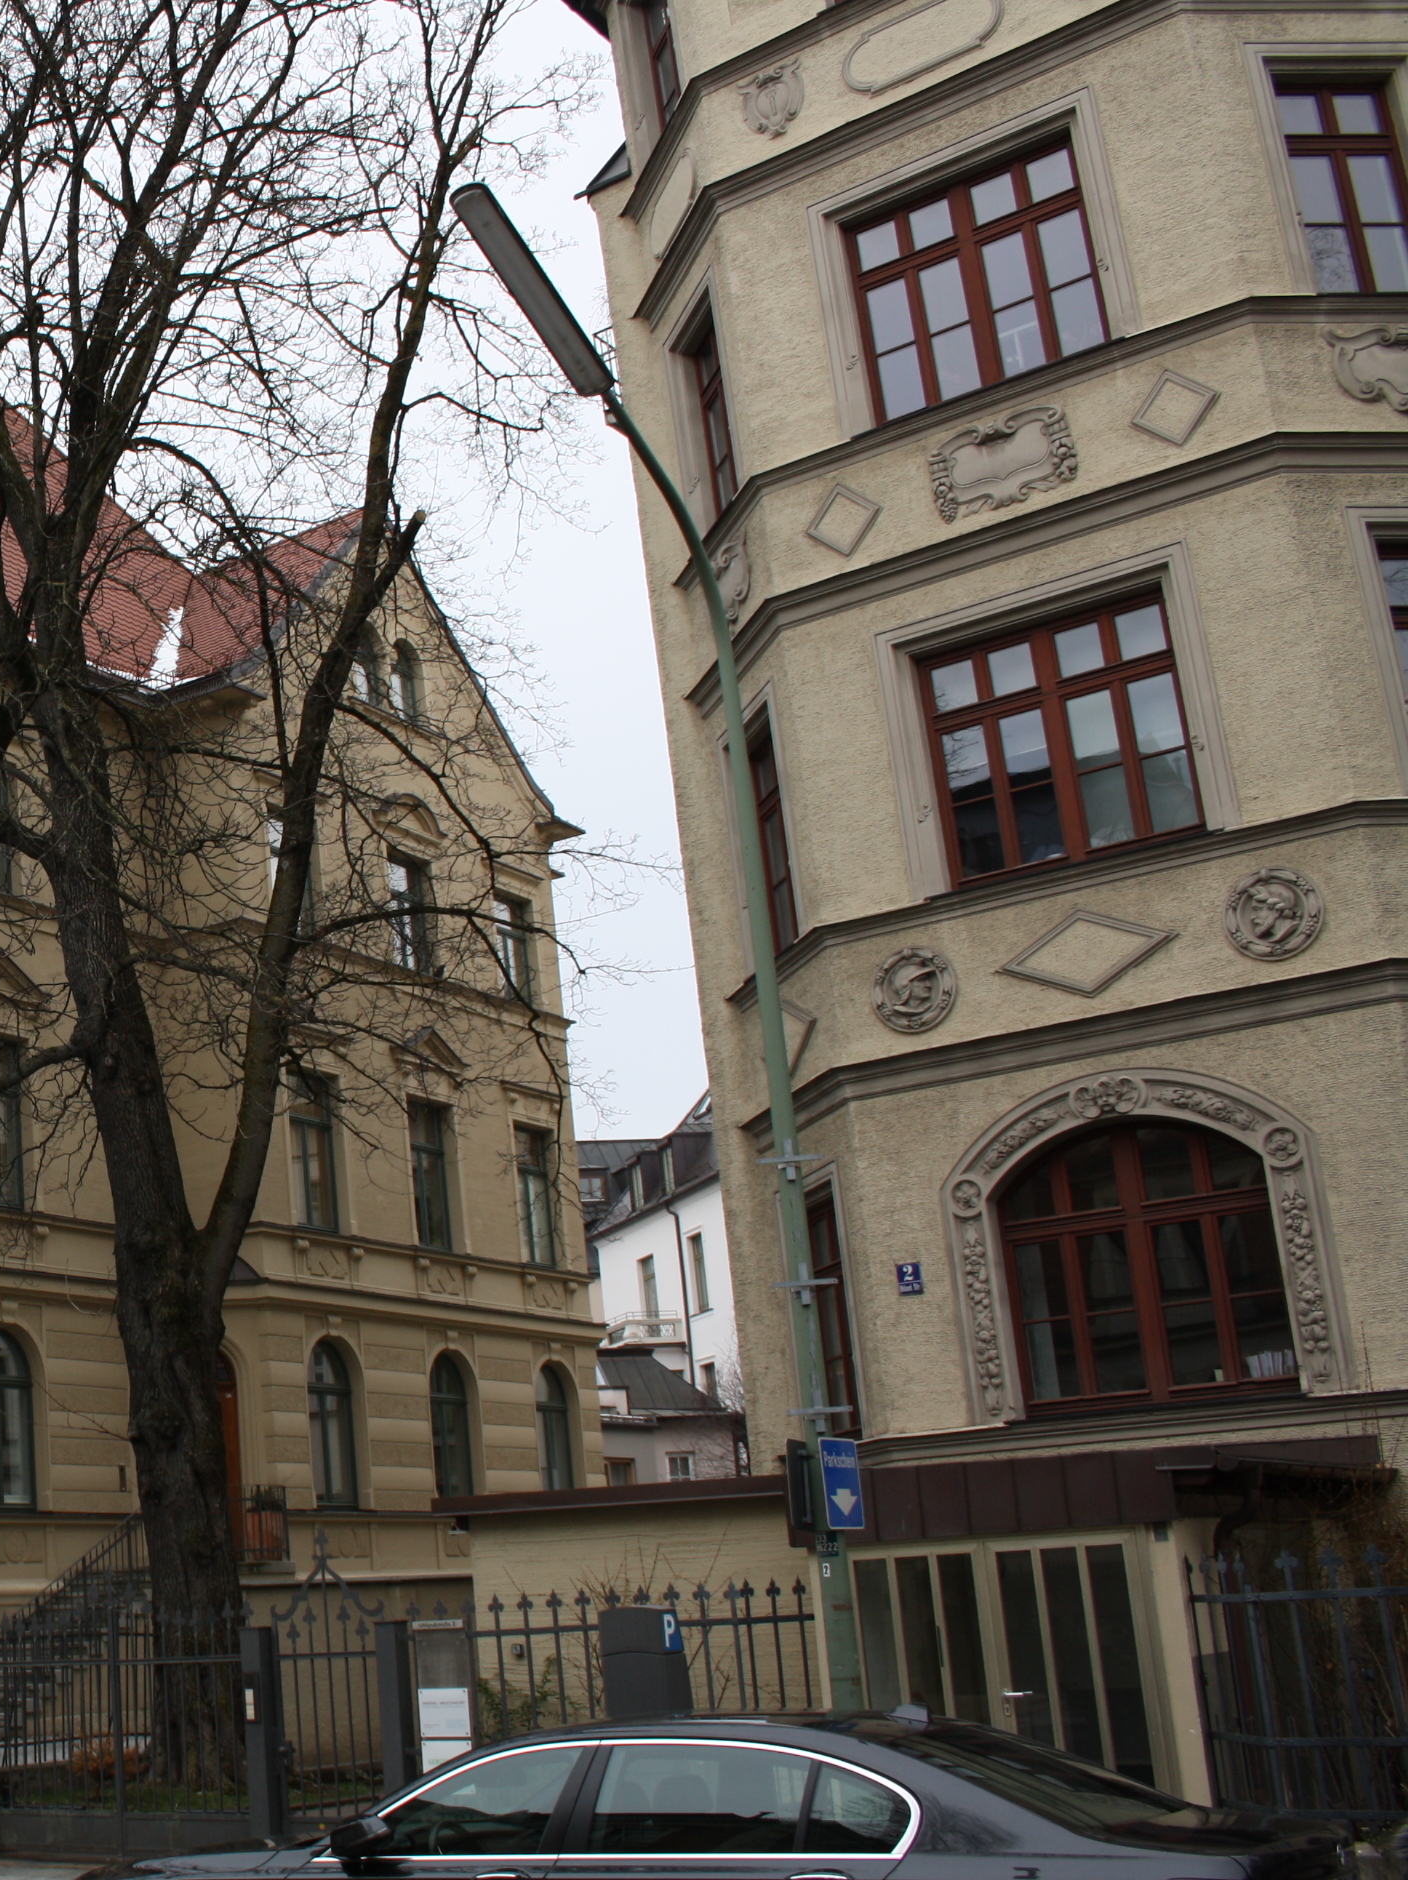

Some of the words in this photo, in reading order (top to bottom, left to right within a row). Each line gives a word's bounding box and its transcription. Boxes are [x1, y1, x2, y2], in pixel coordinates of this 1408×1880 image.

[902, 1265, 914, 1282] 2
[823, 1450, 856, 1468] Parkschein
[662, 1614, 677, 1647] P
